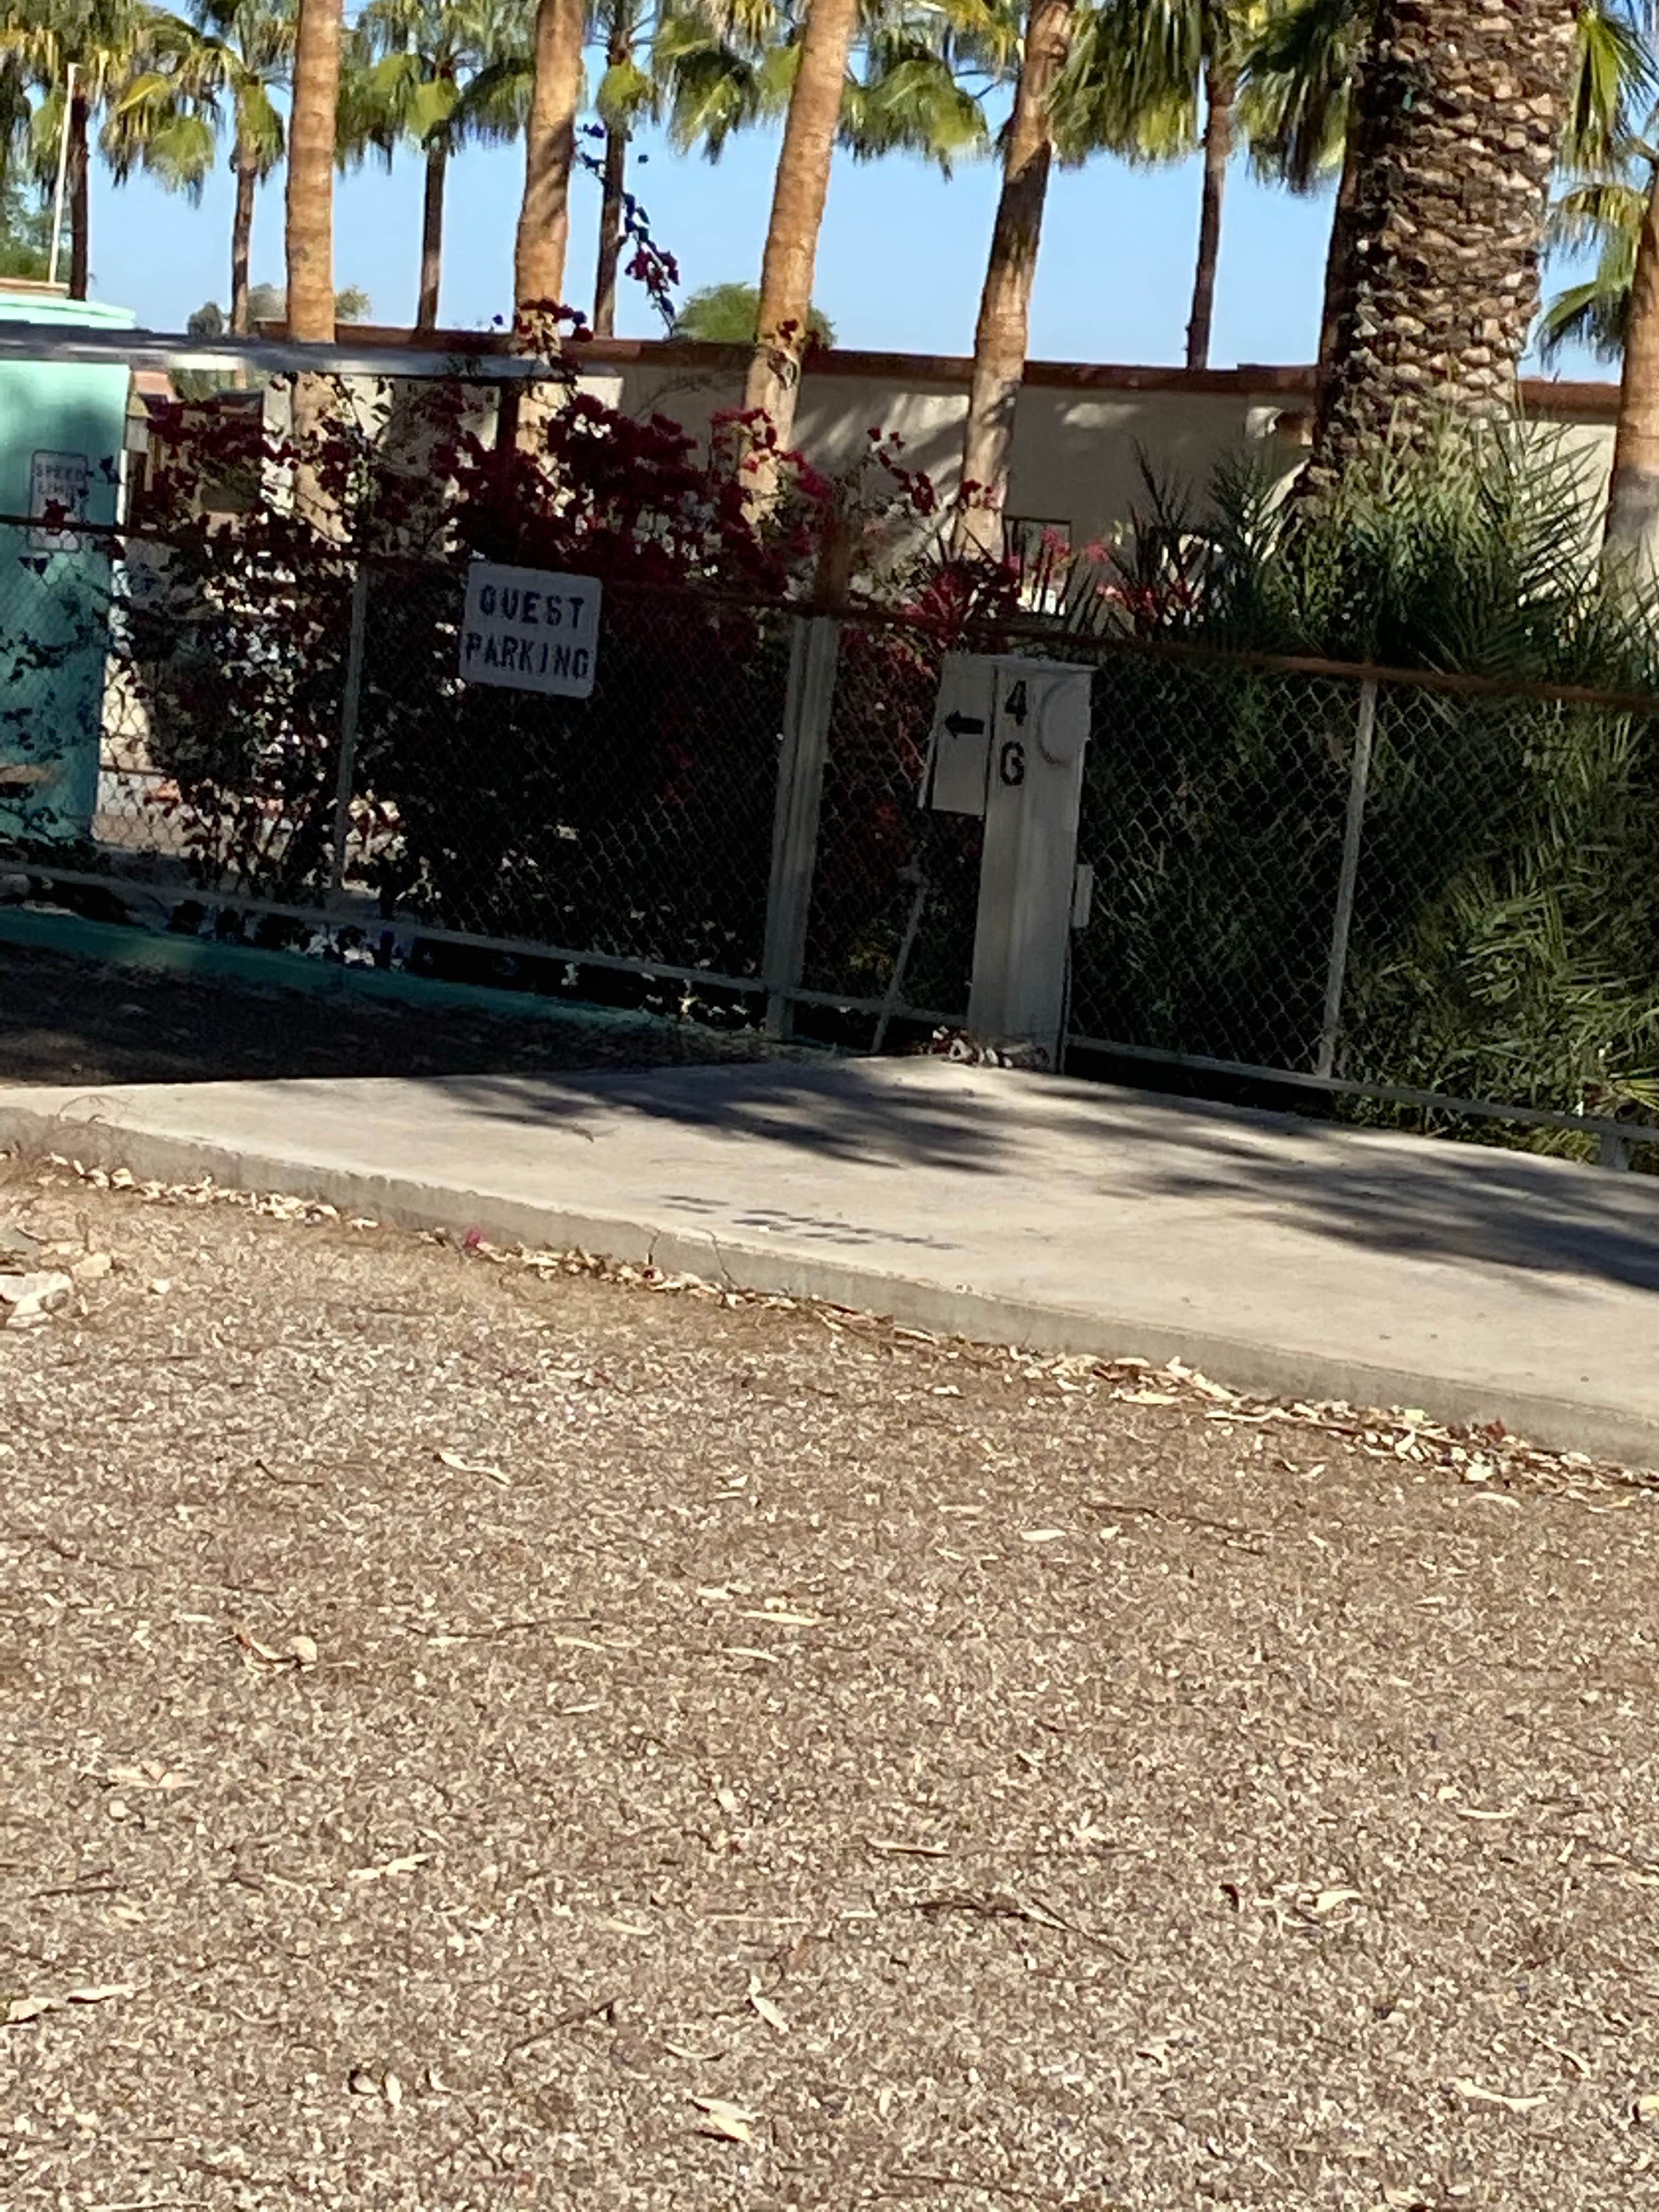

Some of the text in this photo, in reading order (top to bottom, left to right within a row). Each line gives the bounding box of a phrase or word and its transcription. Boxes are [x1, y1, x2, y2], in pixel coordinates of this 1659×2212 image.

[480, 584, 585, 630] GUEST
[466, 632, 590, 680] PARKING
[1005, 680, 1028, 726] 4
